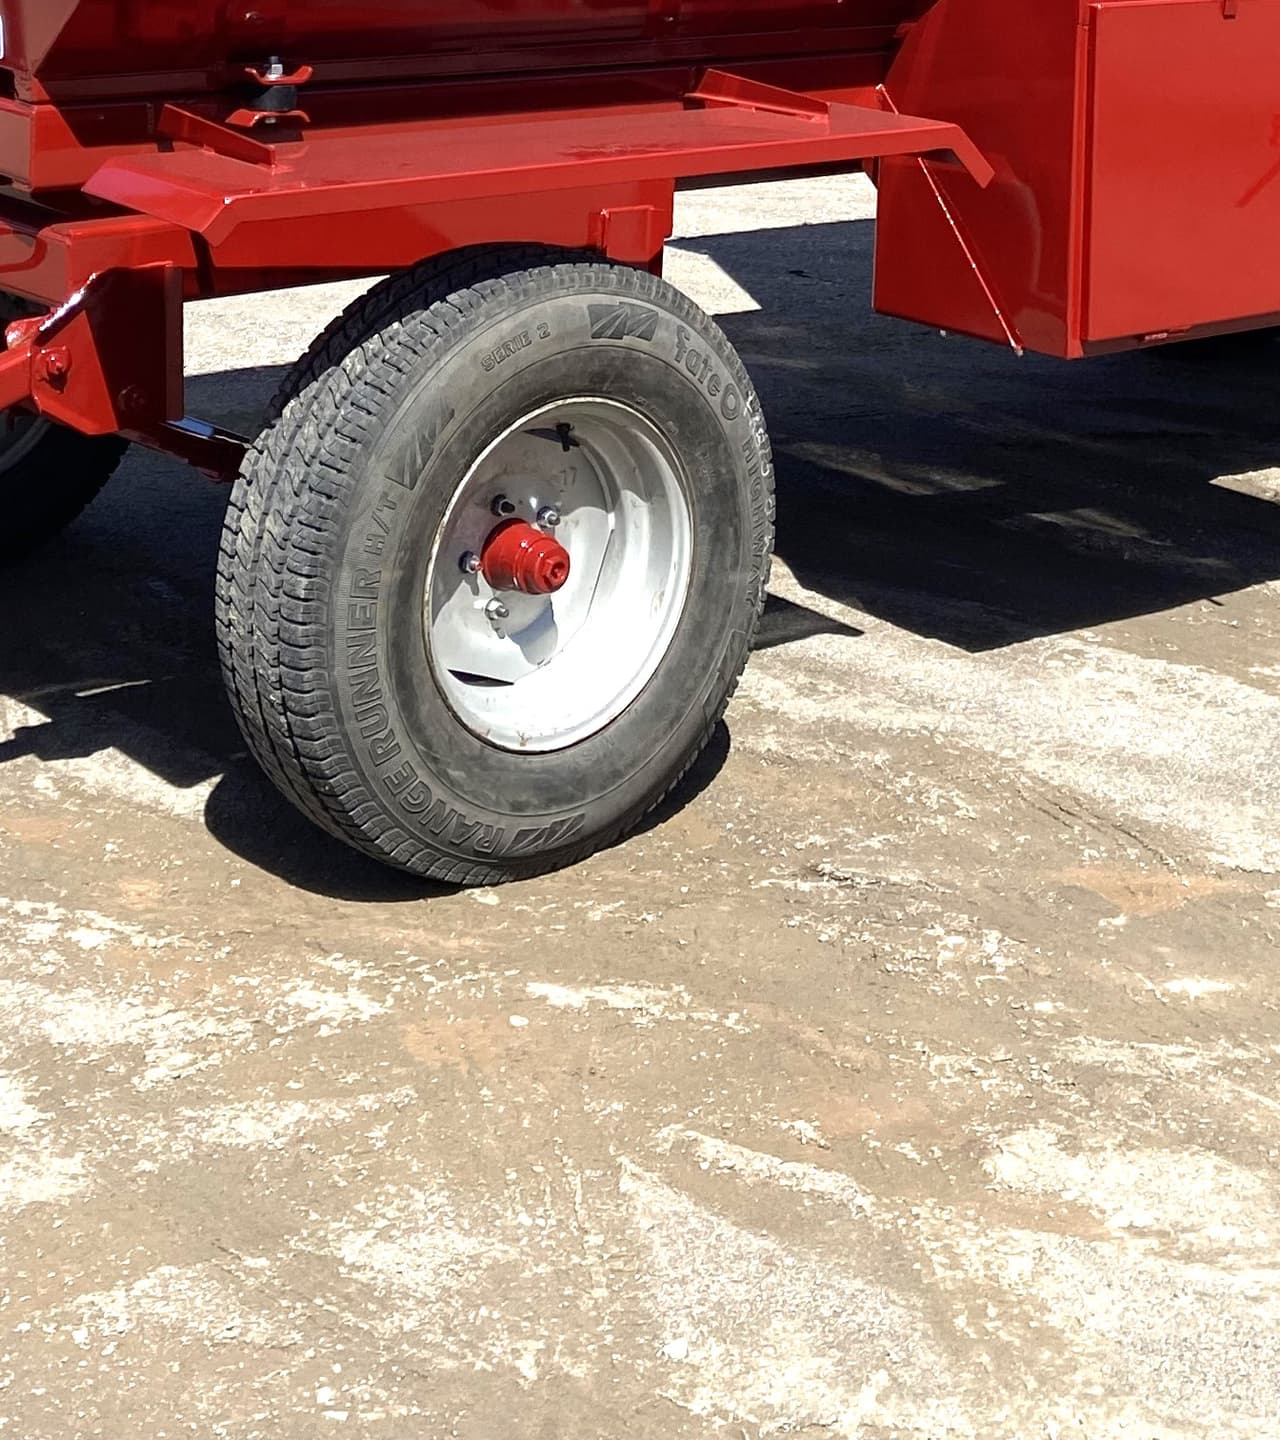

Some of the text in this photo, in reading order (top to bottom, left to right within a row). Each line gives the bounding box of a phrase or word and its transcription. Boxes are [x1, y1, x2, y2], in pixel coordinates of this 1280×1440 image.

[480, 322, 552, 372] SERIE 2
[345, 567, 402, 768] RUNNER
[382, 760, 505, 854] RANGE
